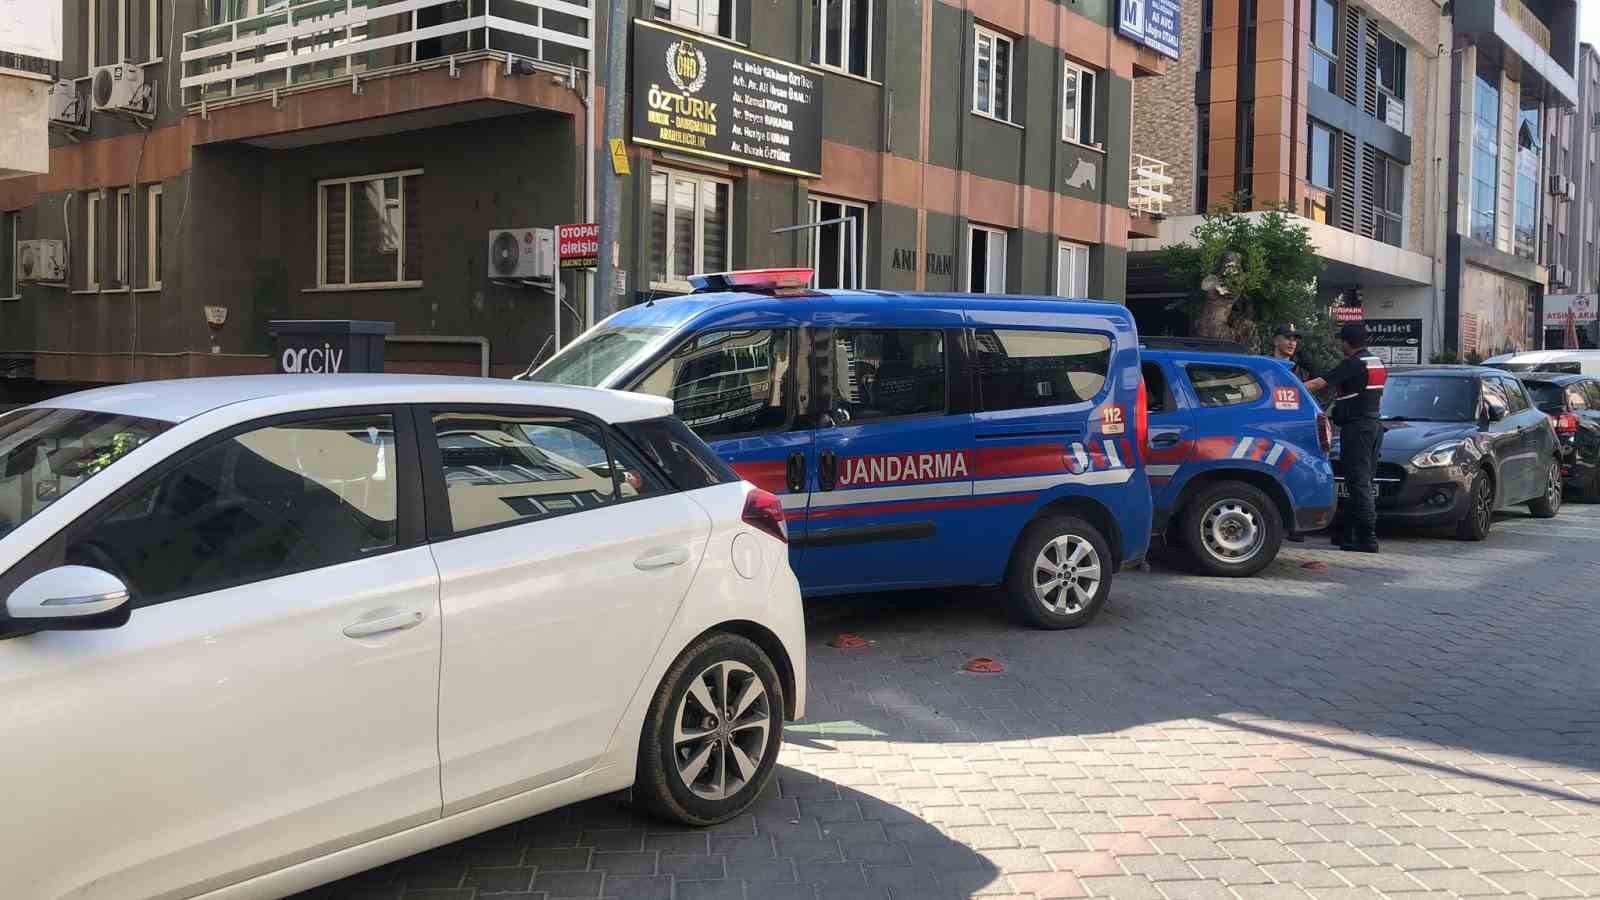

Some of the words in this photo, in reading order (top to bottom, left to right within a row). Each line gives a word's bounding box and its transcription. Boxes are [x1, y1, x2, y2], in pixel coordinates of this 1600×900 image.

[648, 83, 718, 122] ÖZTÜRK
[1276, 389, 1296, 401] 112
[1103, 407, 1121, 423] 112
[839, 452, 968, 485] JANDARMA
